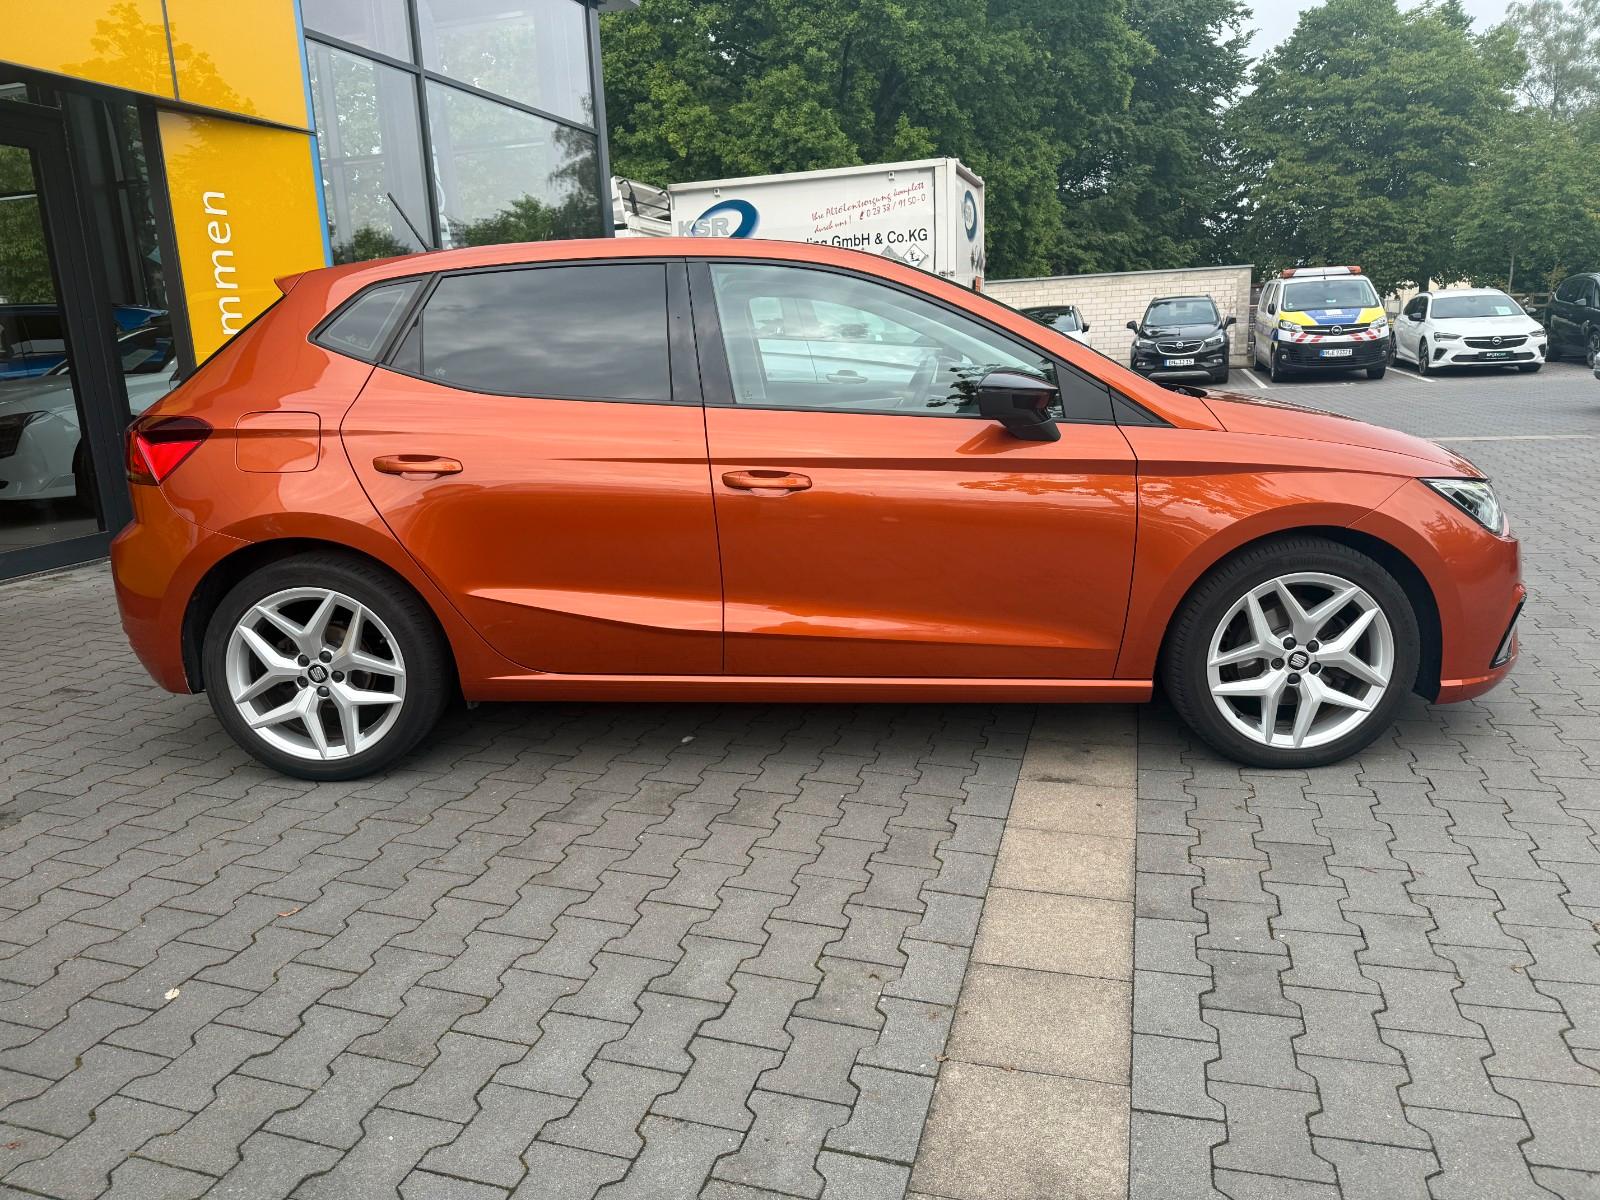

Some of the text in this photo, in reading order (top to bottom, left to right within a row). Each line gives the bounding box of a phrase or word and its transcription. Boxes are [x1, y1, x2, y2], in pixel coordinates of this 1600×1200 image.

[678, 217, 730, 237] KSR
[831, 232, 870, 248] GmbH
[874, 232, 883, 245] &
[202, 191, 243, 335] mmen
